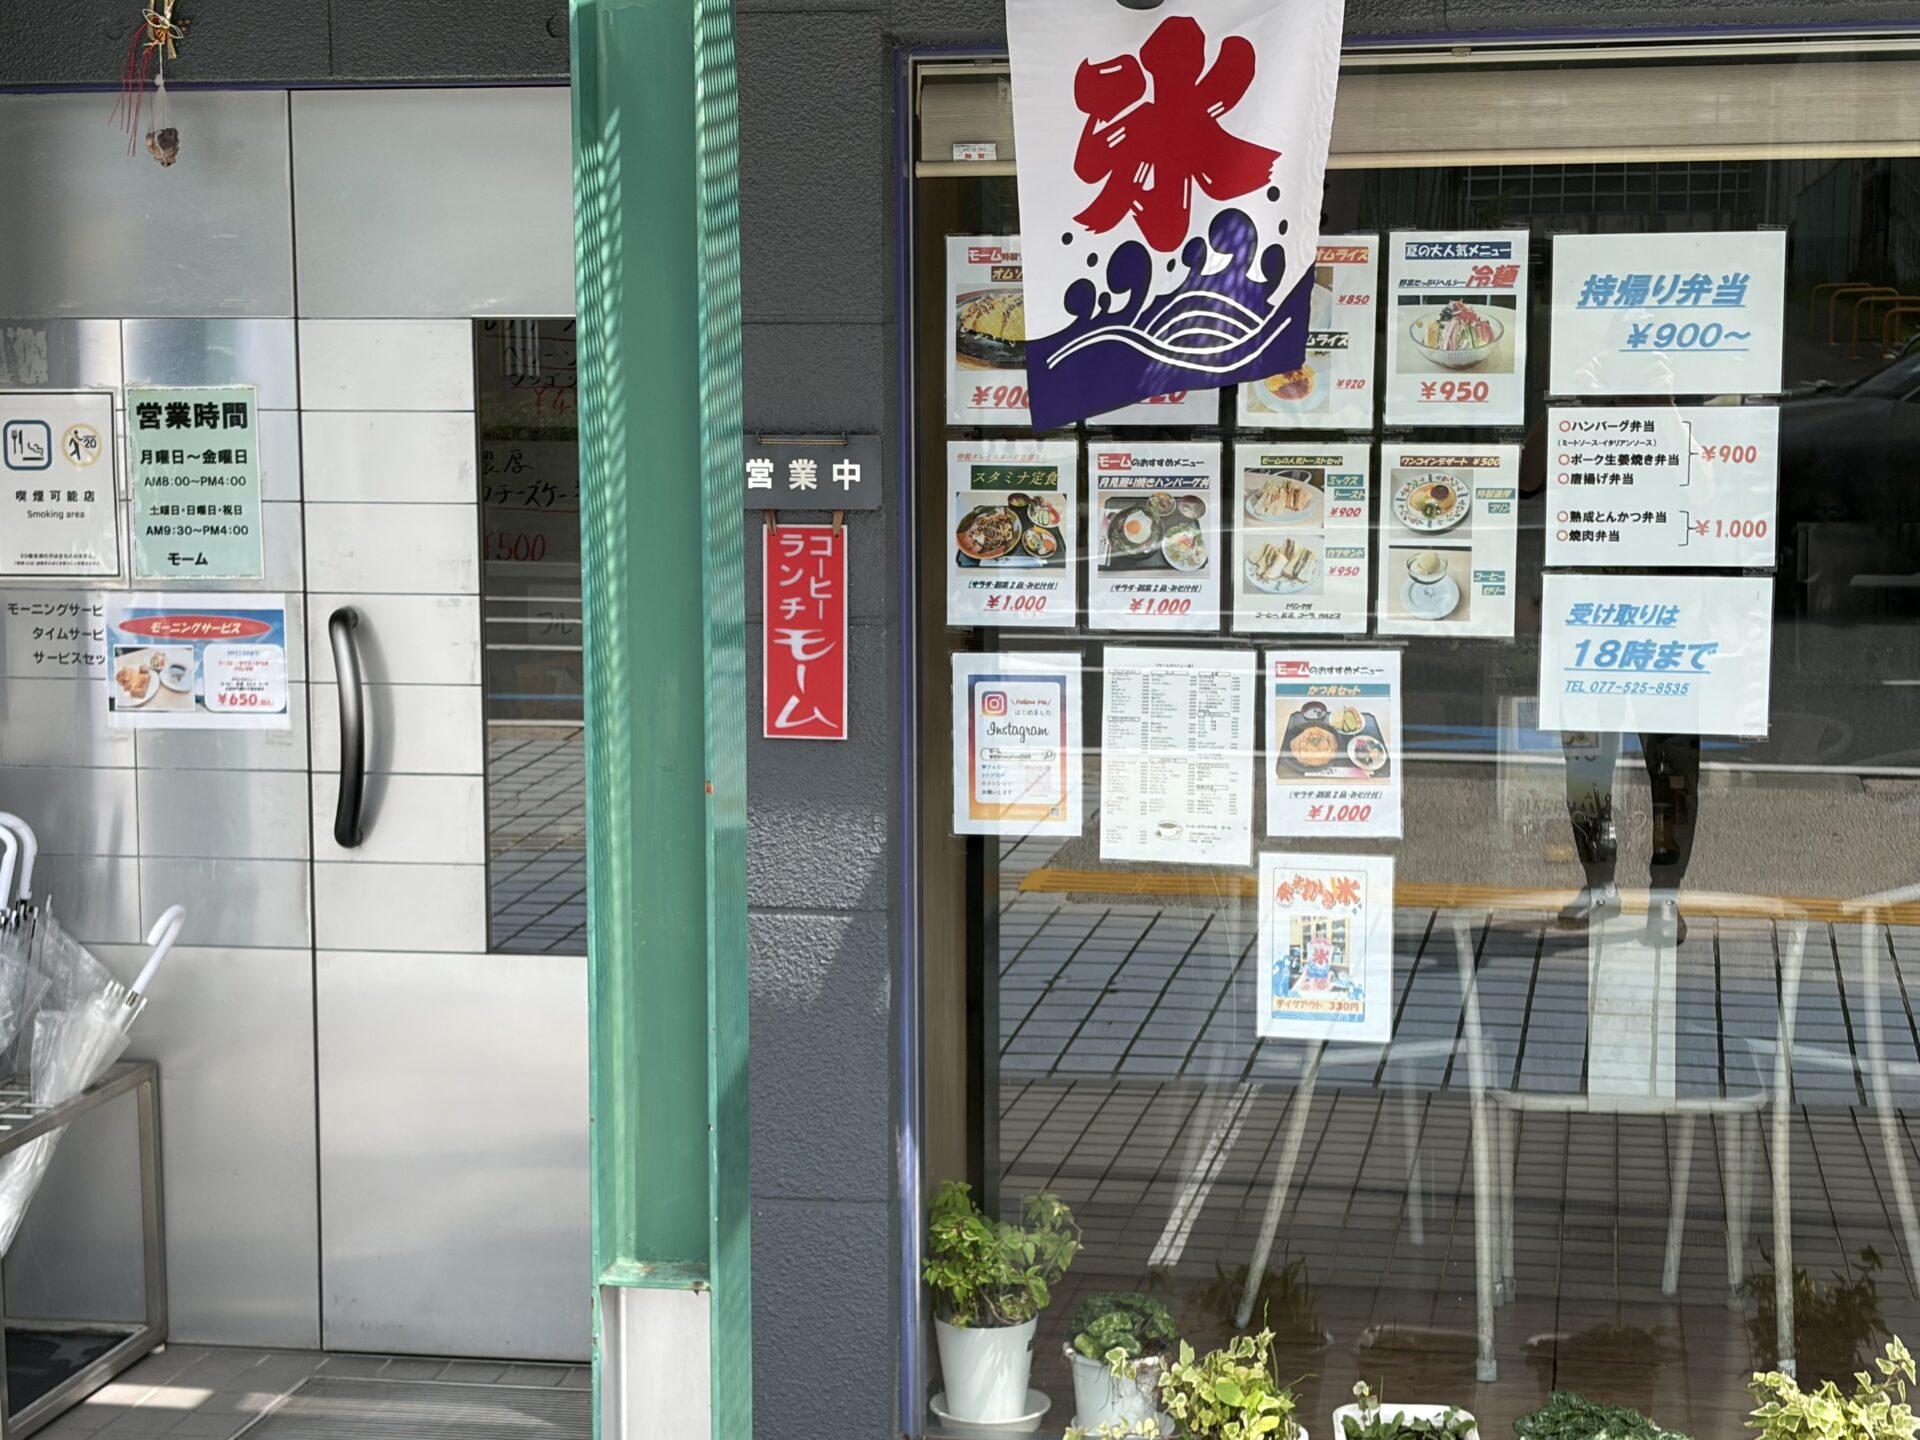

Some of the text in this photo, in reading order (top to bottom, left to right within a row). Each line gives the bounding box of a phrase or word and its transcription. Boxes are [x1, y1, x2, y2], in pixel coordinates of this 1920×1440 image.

[1072, 15, 1283, 253] 氷
[1406, 243, 1511, 257] 夏の大人気メニュー
[1577, 272, 1751, 306] 持帰り弁当
[1338, 295, 1370, 305] ¥850
[1336, 379, 1366, 390] ¥920
[1420, 381, 1490, 402] ¥950
[136, 402, 249, 429] 営業時間
[1571, 419, 1655, 433] ハンバーグ弁当
[1098, 456, 1205, 467] モームのおすすめメニュー
[1701, 445, 1758, 464] ¥900
[1401, 457, 1500, 467] ワンコインデザート ¥500
[745, 459, 862, 491] 営業中
[972, 471, 1059, 485] スタミナ定食
[1328, 476, 1360, 485] ミックス
[1570, 473, 1635, 485] 唐揚げ弁当
[15, 490, 95, 502] 喫煙可能店
[1334, 490, 1365, 500] トースト
[27, 509, 64, 520] Smoking
[1330, 507, 1361, 517] ¥900
[1569, 511, 1668, 523] 熟成とんかつ弁当
[1568, 530, 1621, 542] 焼肉弁当
[167, 551, 209, 567] モーム
[779, 534, 806, 620] ランチ
[808, 535, 832, 620] コーヒー
[1328, 567, 1360, 577] ¥950
[1565, 603, 1681, 626] 受け取りは
[151, 621, 242, 635] モーニングサービス
[1574, 638, 1719, 671] 18時まで
[1275, 662, 1384, 675] モームのおすすめメニュー
[771, 628, 839, 729] モーム
[1307, 685, 1361, 696] かつ丼セット
[1566, 680, 1690, 695] TEL 077-525-8535
[218, 693, 258, 706] ¥650
[986, 721, 1050, 744] Instagram
